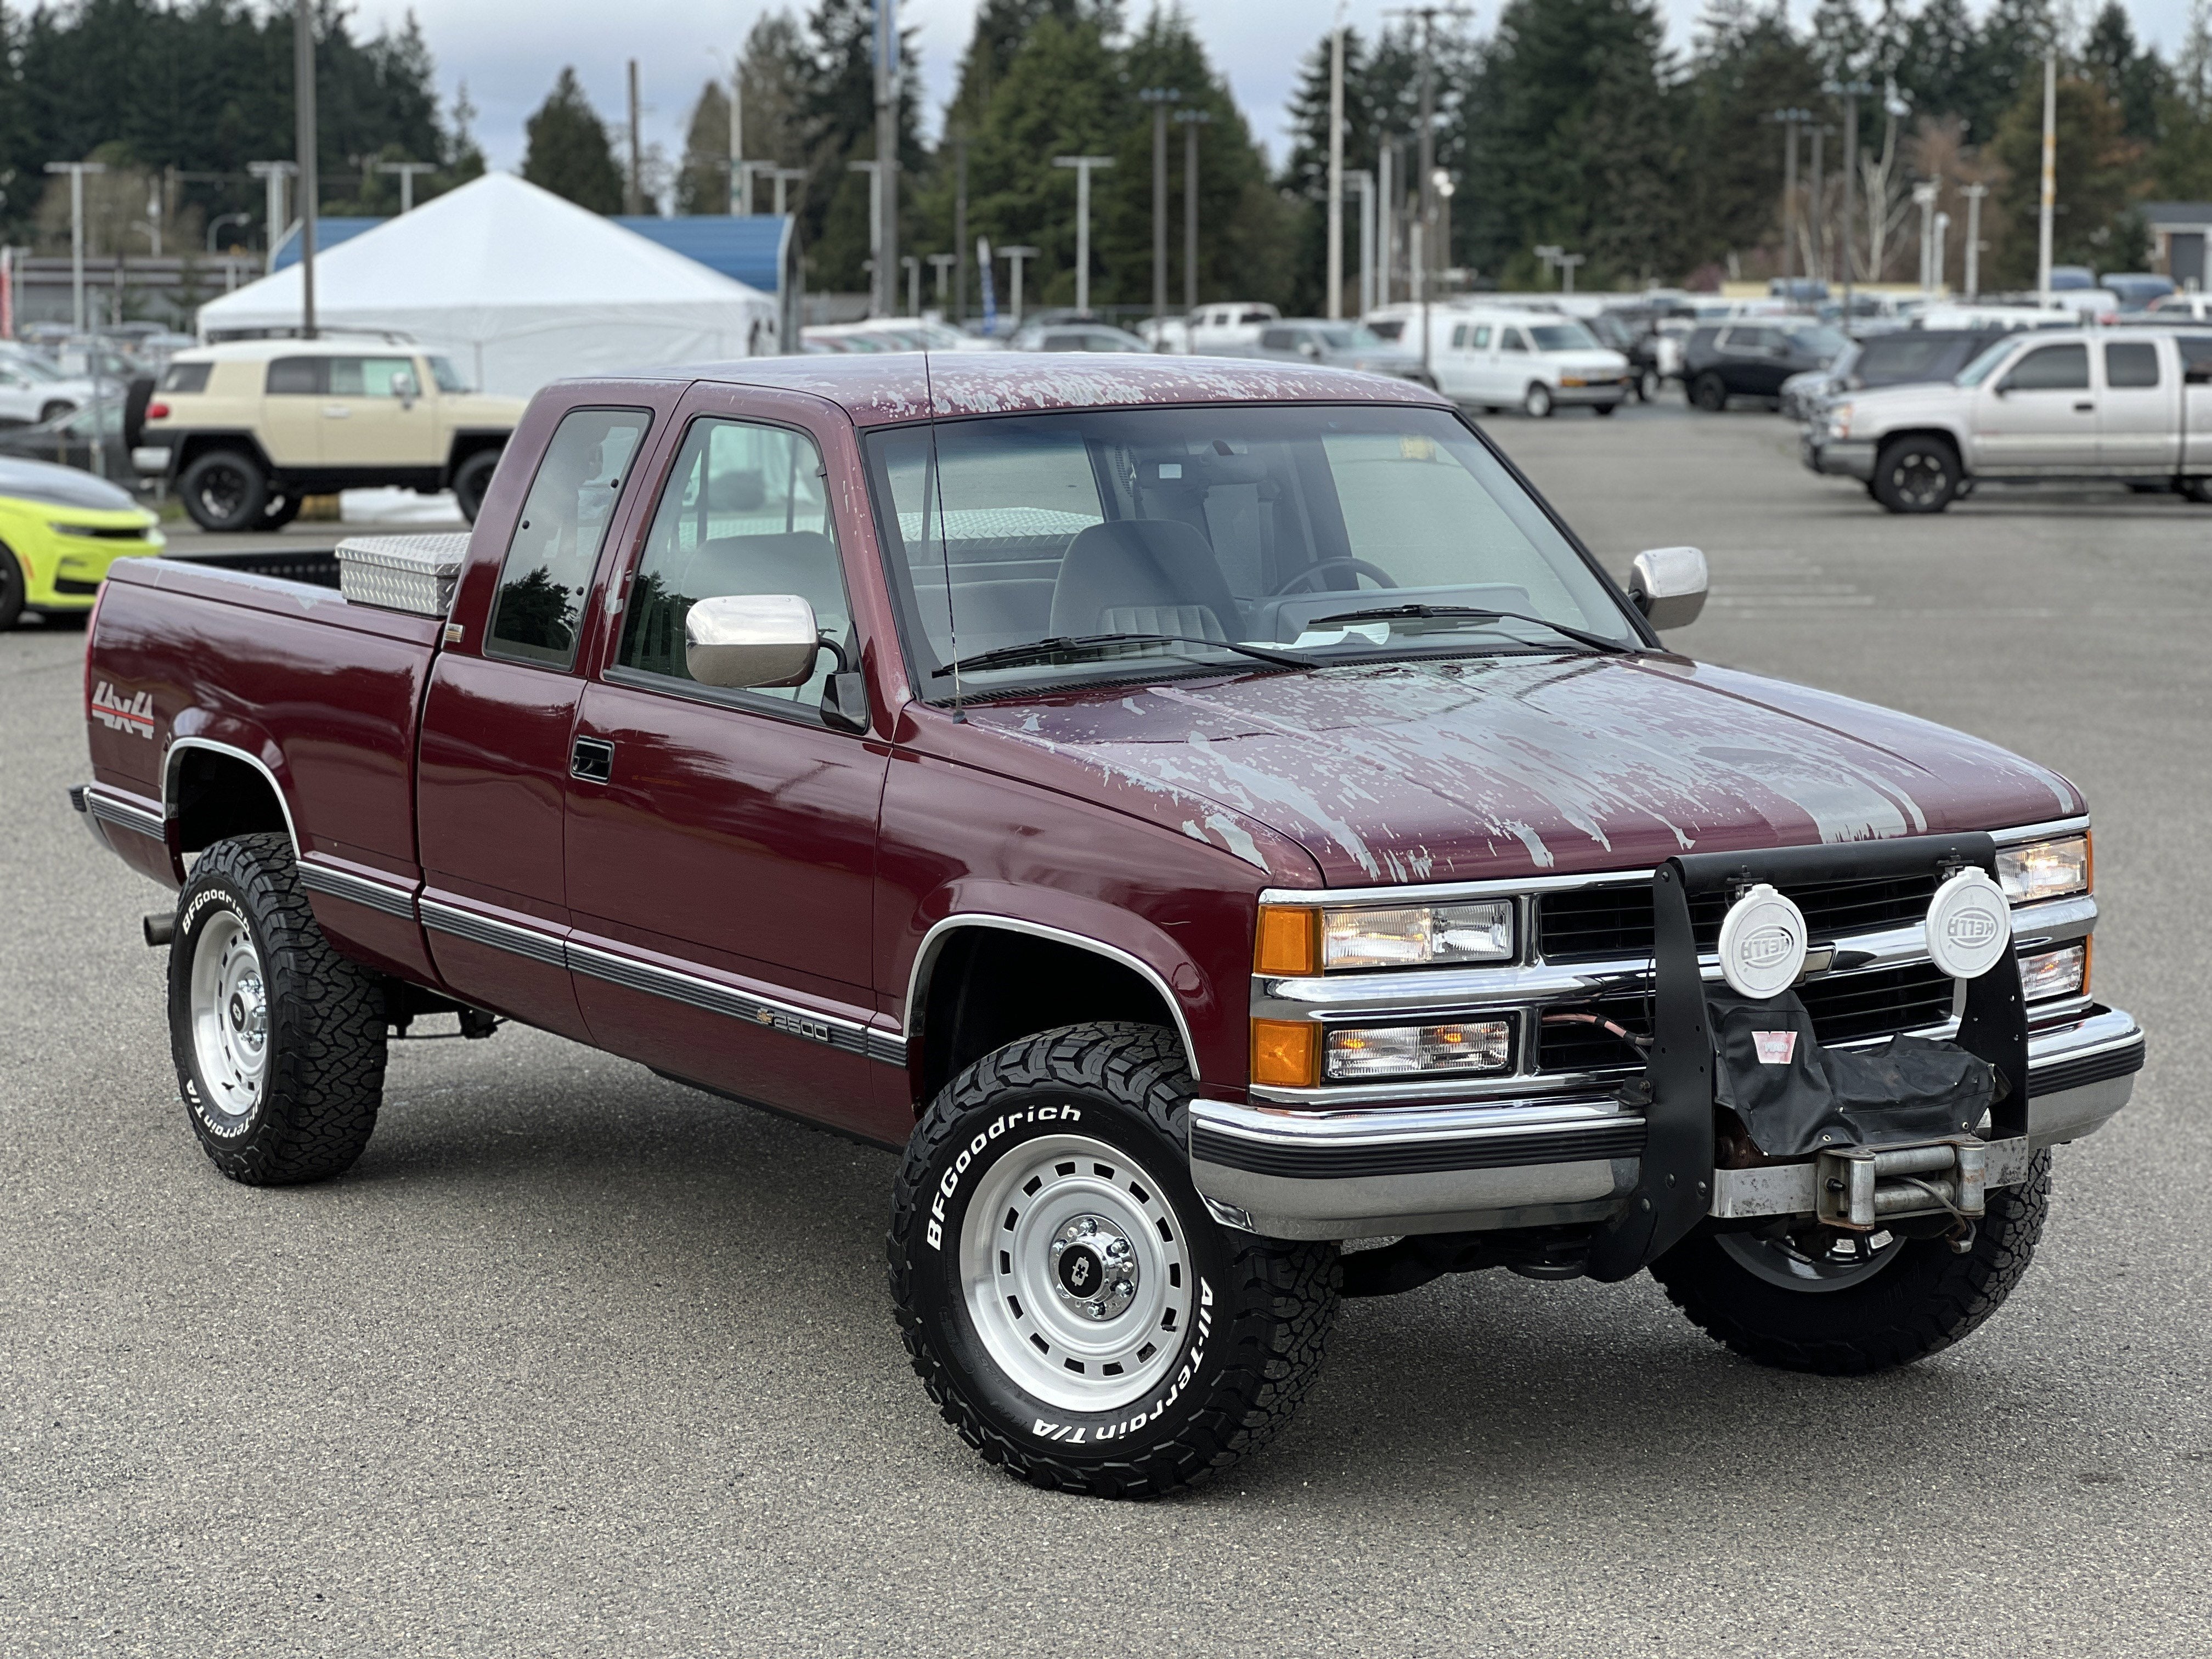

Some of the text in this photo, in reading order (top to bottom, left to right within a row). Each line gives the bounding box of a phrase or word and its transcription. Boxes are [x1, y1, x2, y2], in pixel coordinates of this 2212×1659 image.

[182, 889, 250, 935] BFGoodrich
[1948, 918, 1994, 936] HELLA
[1741, 938, 1790, 960] HELLA
[774, 1015, 828, 1042] 2500
[187, 1079, 262, 1138] All-Terrain T/A
[927, 1104, 1081, 1251] BFGoodrich
[1032, 1277, 1213, 1443] All-Terrain T/A
